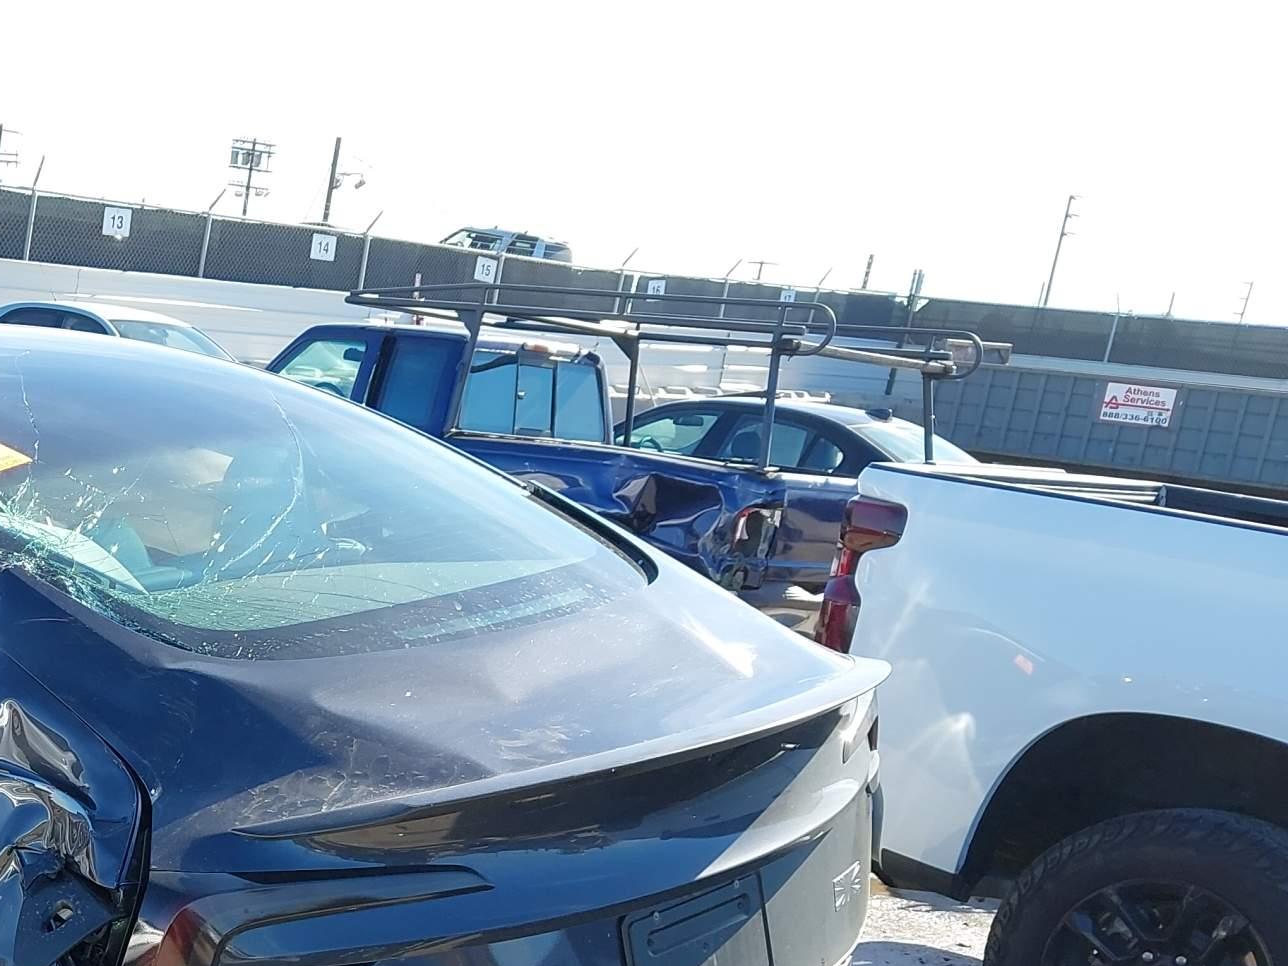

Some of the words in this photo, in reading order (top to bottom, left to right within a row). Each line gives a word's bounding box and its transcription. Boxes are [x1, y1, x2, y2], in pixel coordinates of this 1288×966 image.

[110, 214, 124, 230] 13
[318, 240, 329, 255] 14
[481, 263, 491, 277] 15
[652, 285, 661, 295] 16
[1125, 386, 1161, 398] Athens
[1122, 394, 1167, 407] Services
[1102, 411, 1167, 425] 888/336-6100
